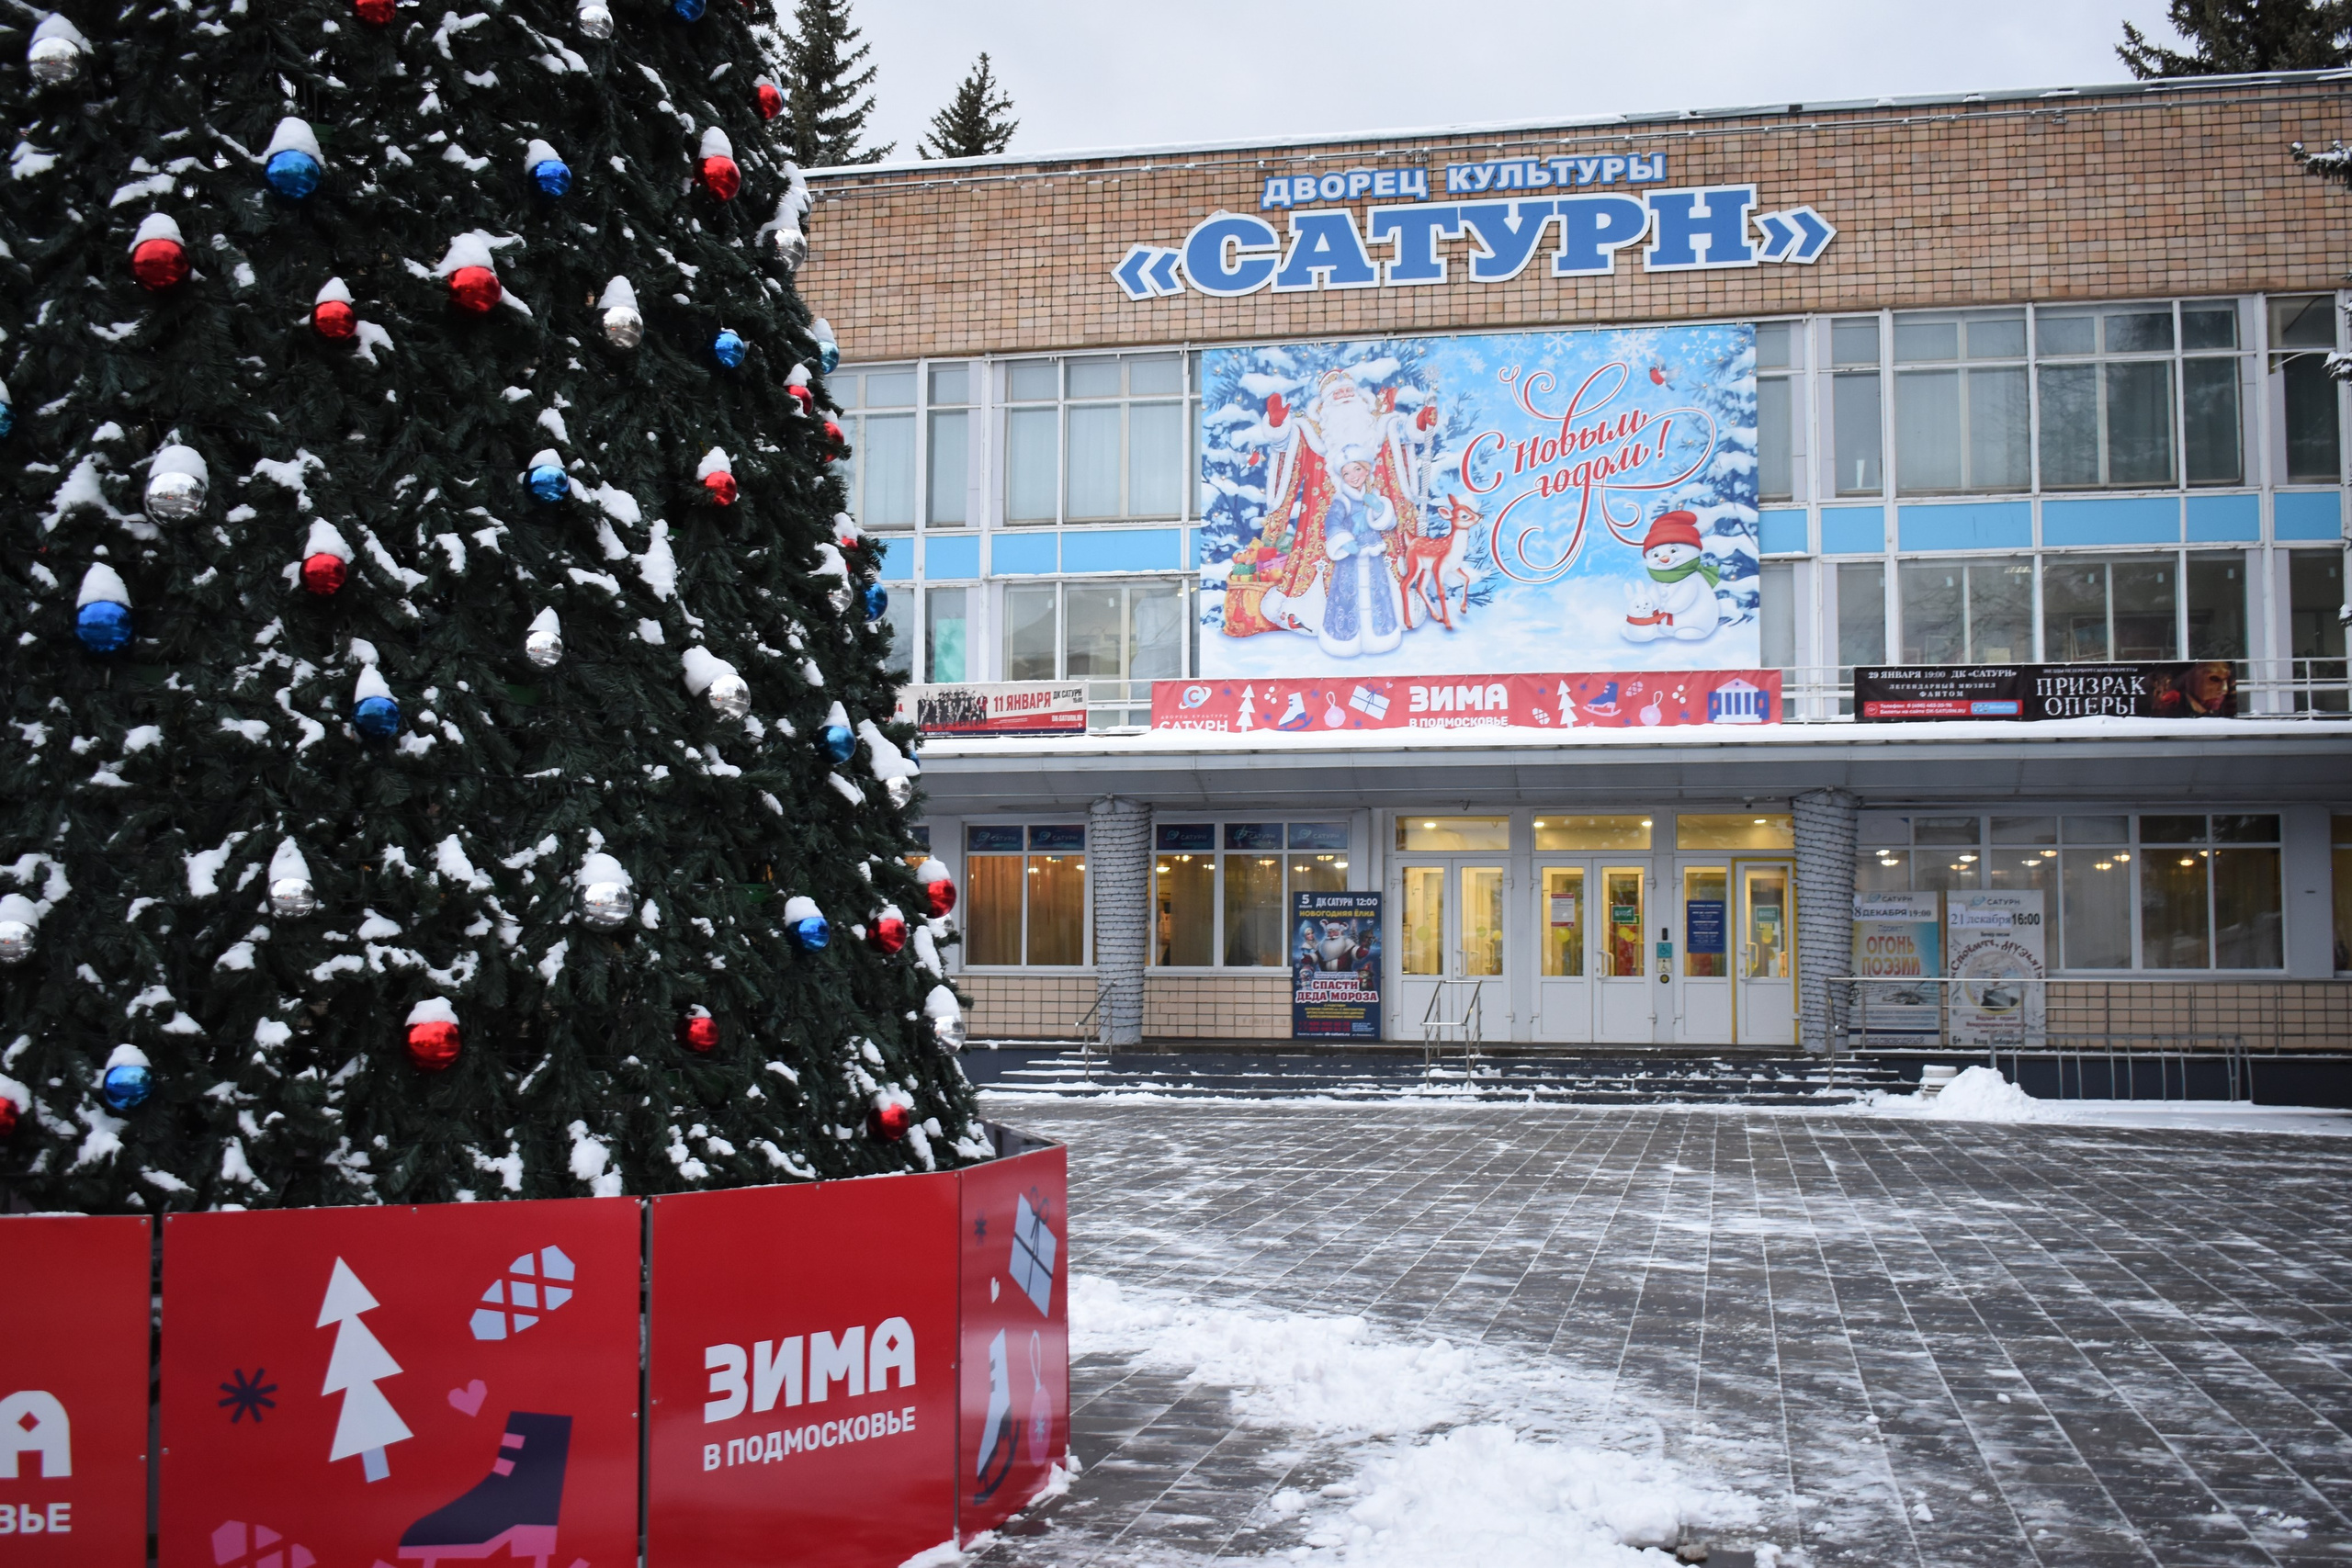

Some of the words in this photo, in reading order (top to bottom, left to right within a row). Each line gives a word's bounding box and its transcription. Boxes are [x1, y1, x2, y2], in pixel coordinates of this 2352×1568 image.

[1262, 169, 1428, 208] ДВОРЕЦ
[1448, 154, 1665, 193] КУЛЬТУРЫ
[1111, 183, 1838, 300] «САТУРН»
[1462, 432, 1504, 493] С
[1498, 362, 1647, 474] Новым
[1881, 671, 1921, 679] ЯНВАРЯ
[1951, 671, 1966, 679] ДК
[1968, 670, 2017, 678] «САТУРН»
[1053, 691, 1061, 700] ДК
[1062, 689, 1082, 698] САТУРН
[2036, 676, 2146, 696] ПРИЗРАК
[994, 696, 1003, 713] 11
[1006, 692, 1051, 711] ЯНВАРЯ
[1409, 683, 1508, 712] ЗИМА
[2044, 696, 2135, 716] ОПЕРЫ
[1409, 718, 1418, 728] В
[1419, 716, 1508, 728] ПОДМОСКОВЬЕ
[1301, 894, 1310, 905] 5
[1316, 897, 1327, 908] ДК
[1327, 897, 1353, 907] САТУРН
[1356, 897, 1378, 907] 12:00
[1354, 908, 1375, 917] ЁЛКА
[1951, 914, 1964, 925] 21
[1967, 914, 2011, 926] декабря
[2012, 913, 2040, 925] 16:00
[1867, 936, 1915, 954] ОГОНЬ
[1862, 957, 1920, 976] ПОЭЗИИ
[1312, 980, 1359, 990] СПАСТИ
[1296, 992, 1328, 1002] ДЕДА
[1330, 992, 1377, 1001] МОРОЗА
[1952, 1035, 1962, 1044] 6+
[705, 1316, 916, 1424] ЗИМА
[704, 1443, 721, 1472] В
[728, 1405, 916, 1465] ПОДМОСКОВЬЕ
